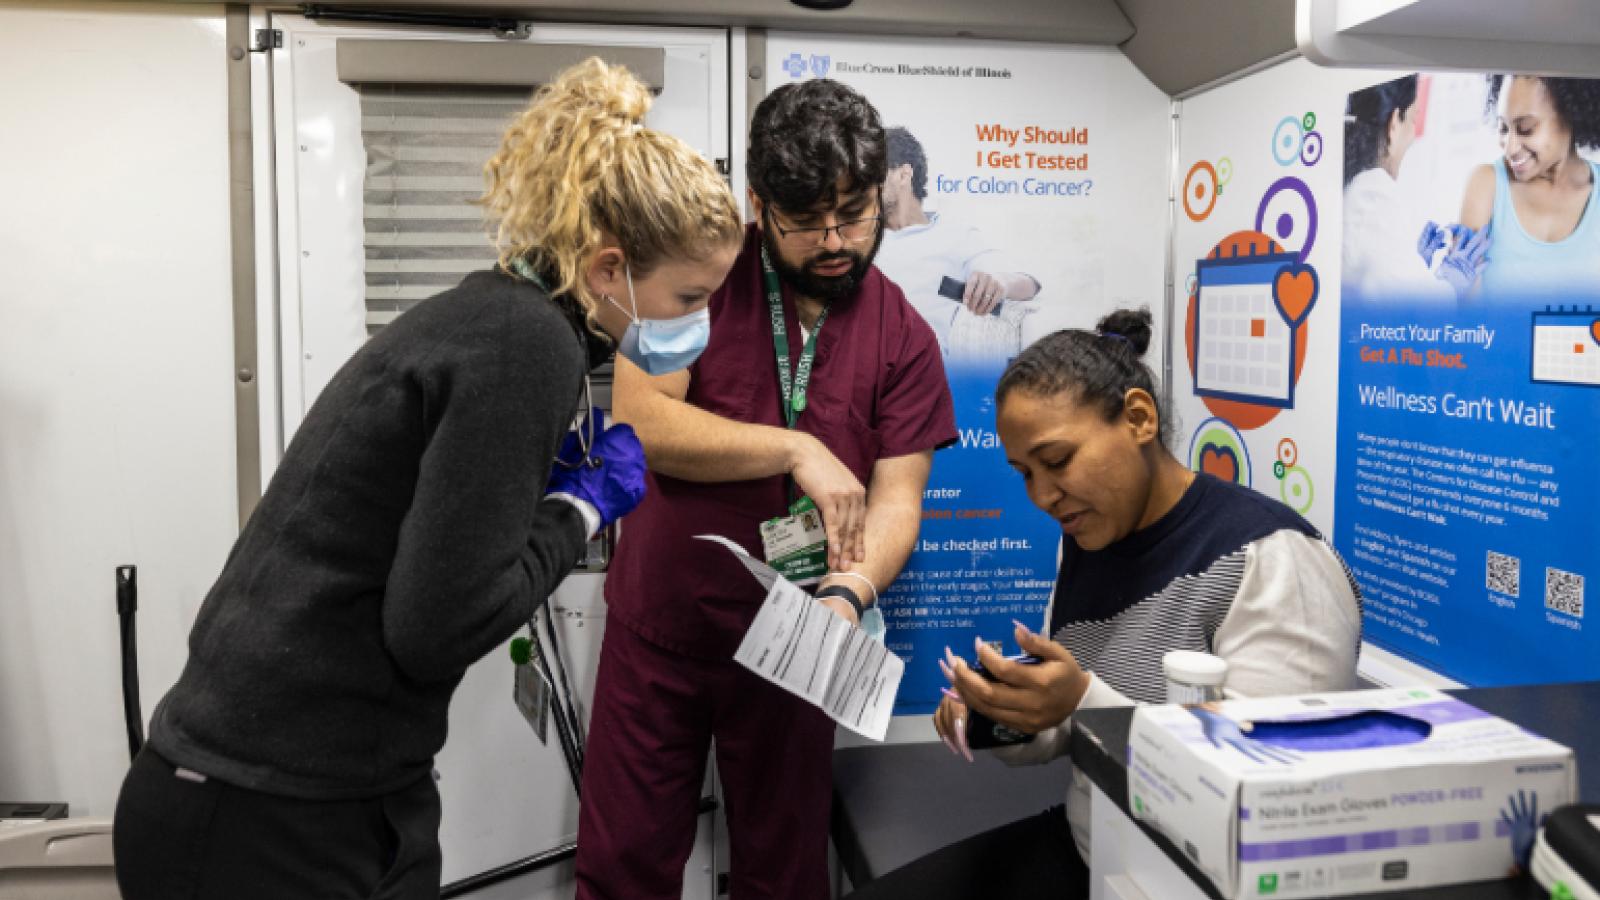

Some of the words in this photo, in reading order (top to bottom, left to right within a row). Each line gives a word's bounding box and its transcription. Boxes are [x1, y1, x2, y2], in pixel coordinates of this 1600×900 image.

[836, 62, 895, 74] BlueCross
[897, 63, 959, 77] BlueShield
[962, 66, 974, 77] of
[975, 67, 1012, 79] Illinois
[976, 124, 1019, 147] Why
[1024, 126, 1088, 145] Should
[977, 151, 983, 167] I
[987, 151, 1021, 168] Get
[1025, 152, 1088, 170] Tested
[936, 174, 960, 193] for
[966, 175, 1019, 194] Colon
[1023, 177, 1093, 196] Cancer?
[1360, 323, 1406, 341] Protect
[1409, 324, 1441, 342] Your
[1444, 325, 1494, 349] Family
[1360, 345, 1384, 363] Get
[1387, 348, 1399, 363] A
[1401, 348, 1423, 366] Flu
[1427, 349, 1468, 369] Shot.
[795, 353, 814, 386] RUSH
[1358, 383, 1437, 414] Wellness
[1441, 393, 1494, 423] Can't
[1499, 398, 1556, 429] Wait
[959, 429, 1000, 449] Wai
[1458, 448, 1476, 463] they
[1477, 453, 1492, 463] can
[1493, 456, 1508, 468] get
[1510, 456, 1553, 473] influenza
[1480, 468, 1494, 478] call
[1495, 470, 1511, 482] the
[1512, 472, 1526, 484] flu
[1539, 480, 1559, 494] any
[1456, 476, 1468, 487] for
[1469, 479, 1502, 495] Disease
[1504, 486, 1539, 503] Control
[1540, 495, 1559, 507] and
[920, 509, 952, 519] olon
[955, 509, 1003, 519] cancer
[1510, 504, 1549, 521] months
[923, 540, 940, 551] be
[943, 538, 997, 551] checked
[1001, 537, 1032, 550] first.
[927, 570, 951, 579] cause
[953, 569, 962, 578] of
[964, 570, 992, 578] cancer
[1025, 567, 1034, 576] in
[887, 583, 910, 593] able
[937, 582, 959, 593] early
[992, 580, 1012, 590] Your
[973, 593, 993, 604] your
[894, 607, 912, 617] ASK
[1545, 611, 1582, 632] Spanish
[895, 620, 927, 630] before
[1258, 805, 1298, 820] Nitrile
[1302, 800, 1337, 817] Exam
[1340, 797, 1388, 812] Gloves
[1390, 786, 1484, 805] POWDER-FREE
